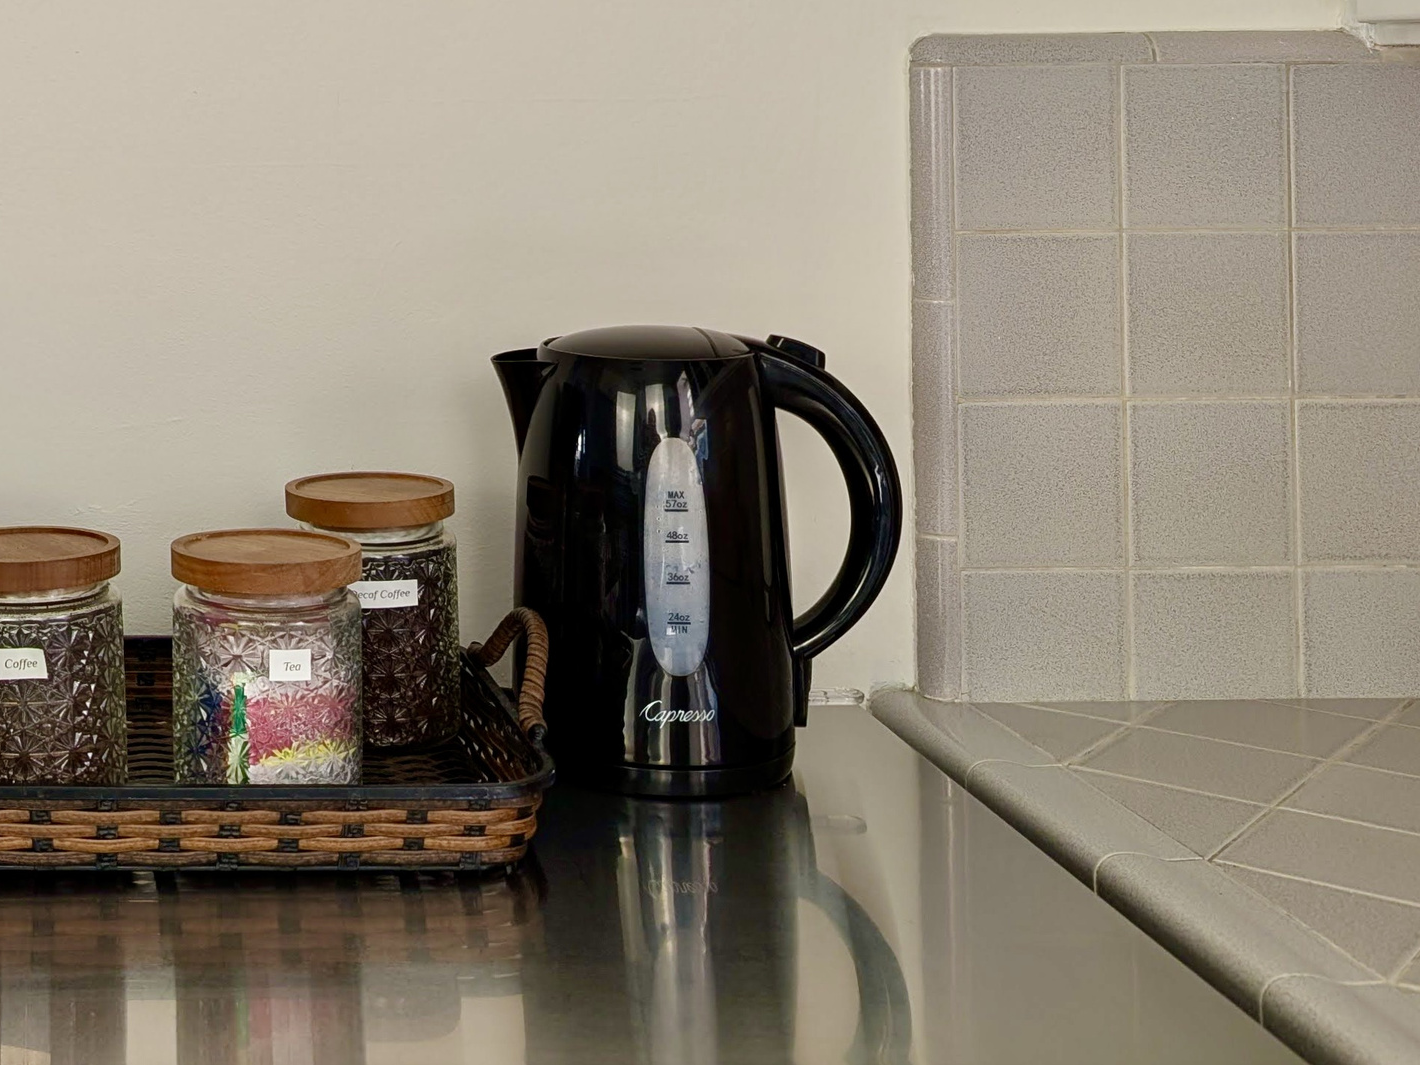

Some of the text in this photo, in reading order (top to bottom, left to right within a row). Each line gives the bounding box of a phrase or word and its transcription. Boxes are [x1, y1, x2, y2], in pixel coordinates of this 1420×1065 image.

[667, 491, 685, 499] MAX
[665, 500, 688, 508] 57oz
[666, 531, 689, 540] 48oz
[667, 573, 689, 582] 36oz
[380, 588, 411, 600] Coffee
[668, 613, 690, 621] 24oz
[671, 626, 688, 634] MIN
[4, 658, 38, 671] Coffee
[283, 661, 302, 672] Tea
[639, 700, 715, 729] Capresso
